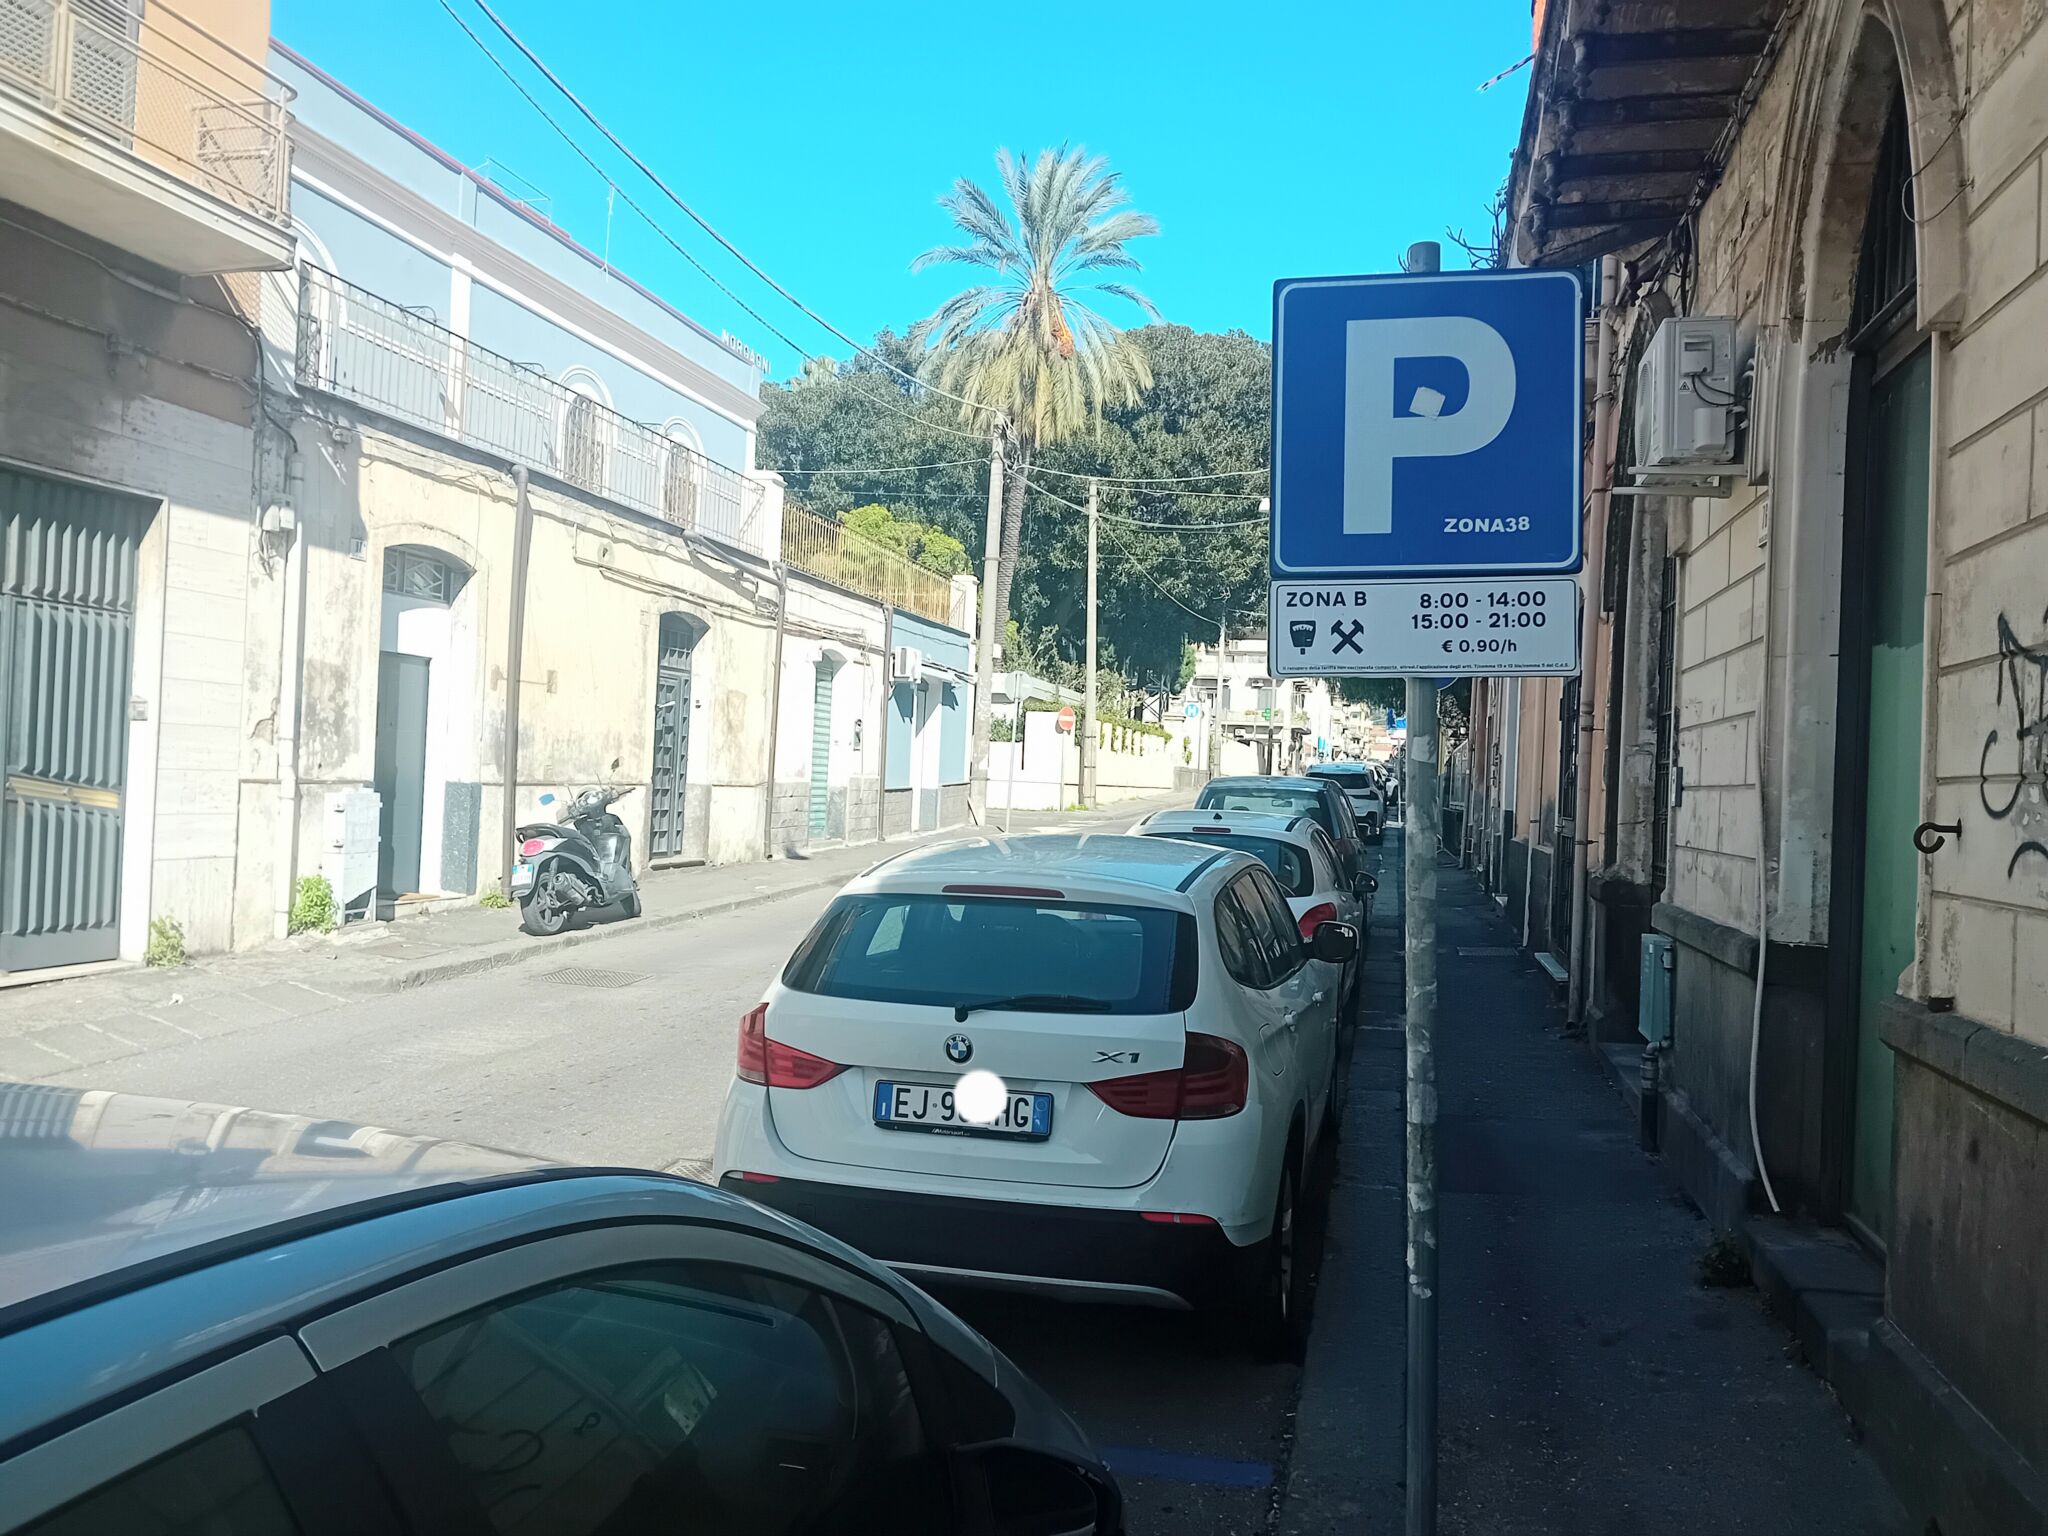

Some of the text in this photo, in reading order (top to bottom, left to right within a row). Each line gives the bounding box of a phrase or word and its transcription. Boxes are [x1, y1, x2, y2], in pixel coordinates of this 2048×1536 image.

[1343, 316, 1517, 535] P
[1444, 516, 1530, 533] ZONA38
[1286, 591, 1368, 607] ZONA B
[1420, 592, 1469, 609] 8:00
[1487, 591, 1547, 607] 14:00
[1411, 613, 1469, 629] 15:00
[1489, 611, 1547, 628] 21:00
[1442, 639, 1517, 654] € 0.90/h
[1091, 1050, 1141, 1064] X1
